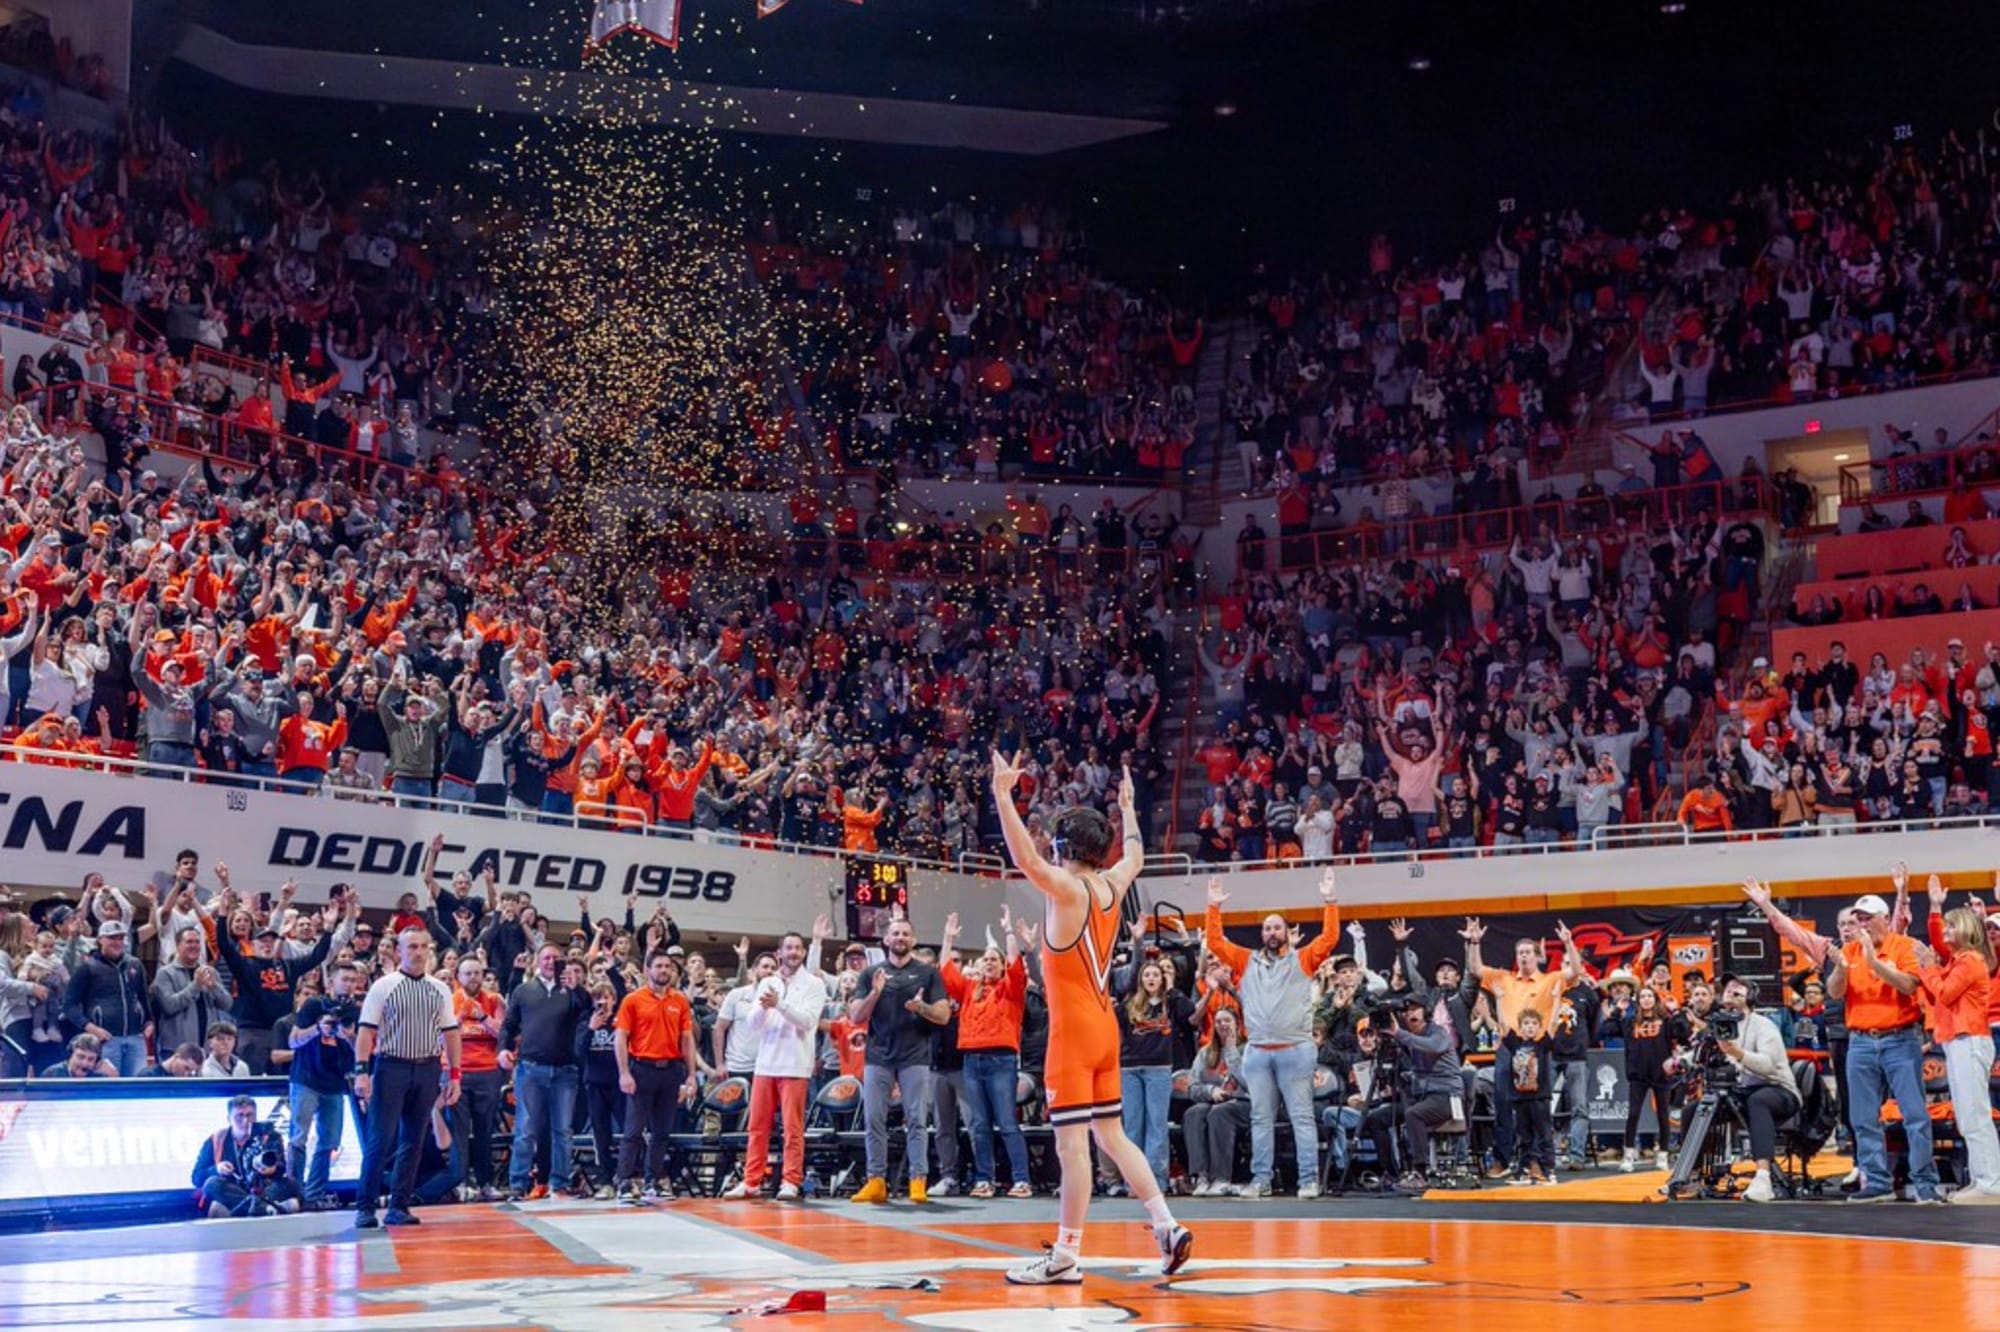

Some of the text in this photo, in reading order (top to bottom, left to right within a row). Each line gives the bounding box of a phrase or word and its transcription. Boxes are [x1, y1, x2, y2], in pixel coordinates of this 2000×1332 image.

[1893, 123, 1913, 140] 324
[1498, 197, 1516, 213] 323
[226, 790, 248, 812] 109
[0, 792, 145, 859] NA
[268, 826, 736, 902] DEDICATED 1938
[27, 1124, 199, 1168] venmo
